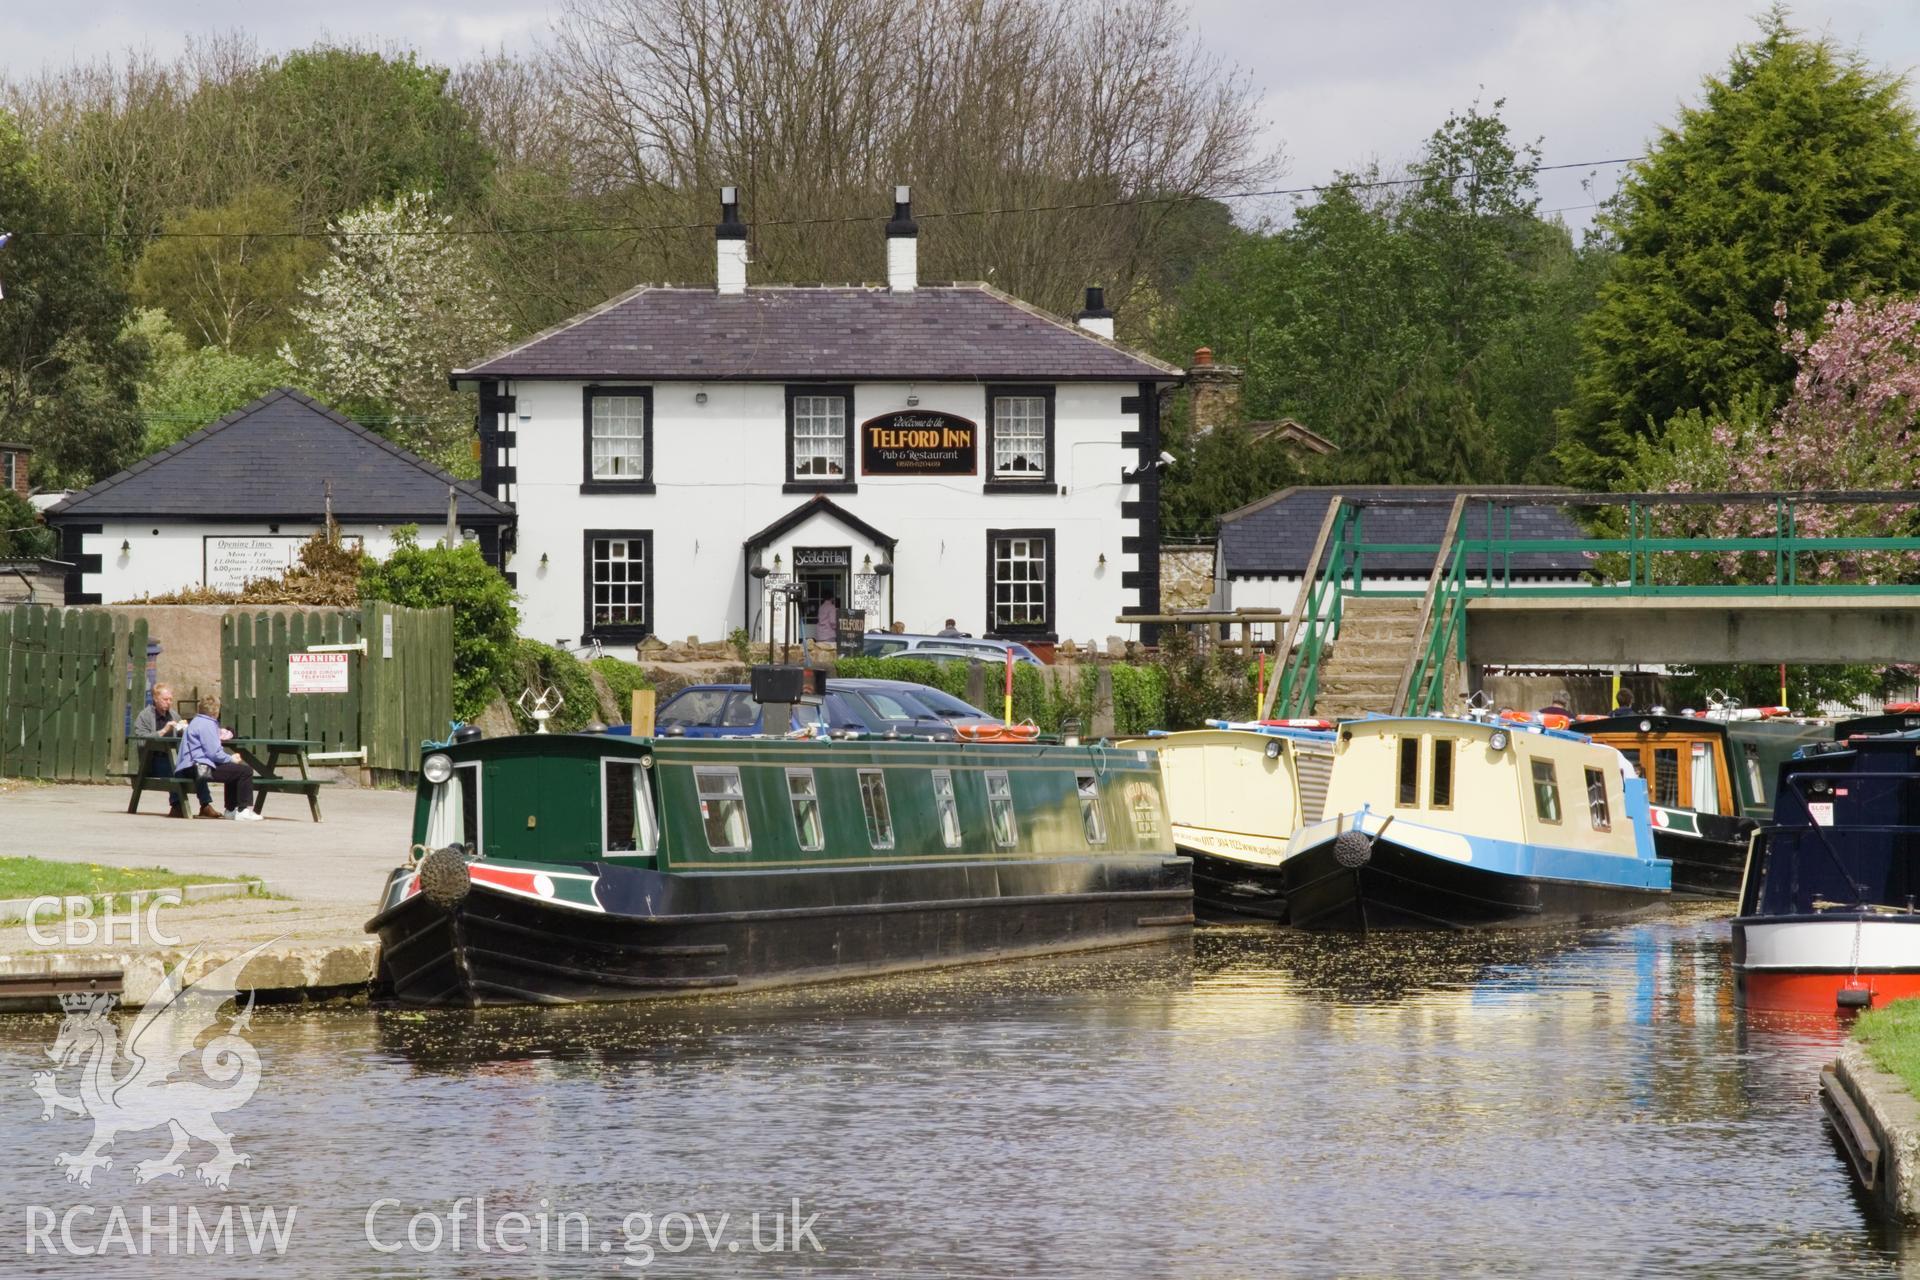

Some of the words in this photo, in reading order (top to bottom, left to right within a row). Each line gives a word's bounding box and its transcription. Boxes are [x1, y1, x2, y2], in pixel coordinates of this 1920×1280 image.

[894, 416, 926, 428] Welcome
[934, 417, 945, 428] the
[869, 427, 940, 448] TELFORD
[943, 428, 971, 448] INN
[879, 449, 898, 459] Pub
[907, 449, 958, 461] Restaurant
[217, 540, 249, 549] Opening
[251, 540, 272, 548] Times
[839, 618, 864, 631] TELFORD
[292, 655, 344, 663] WARNING
